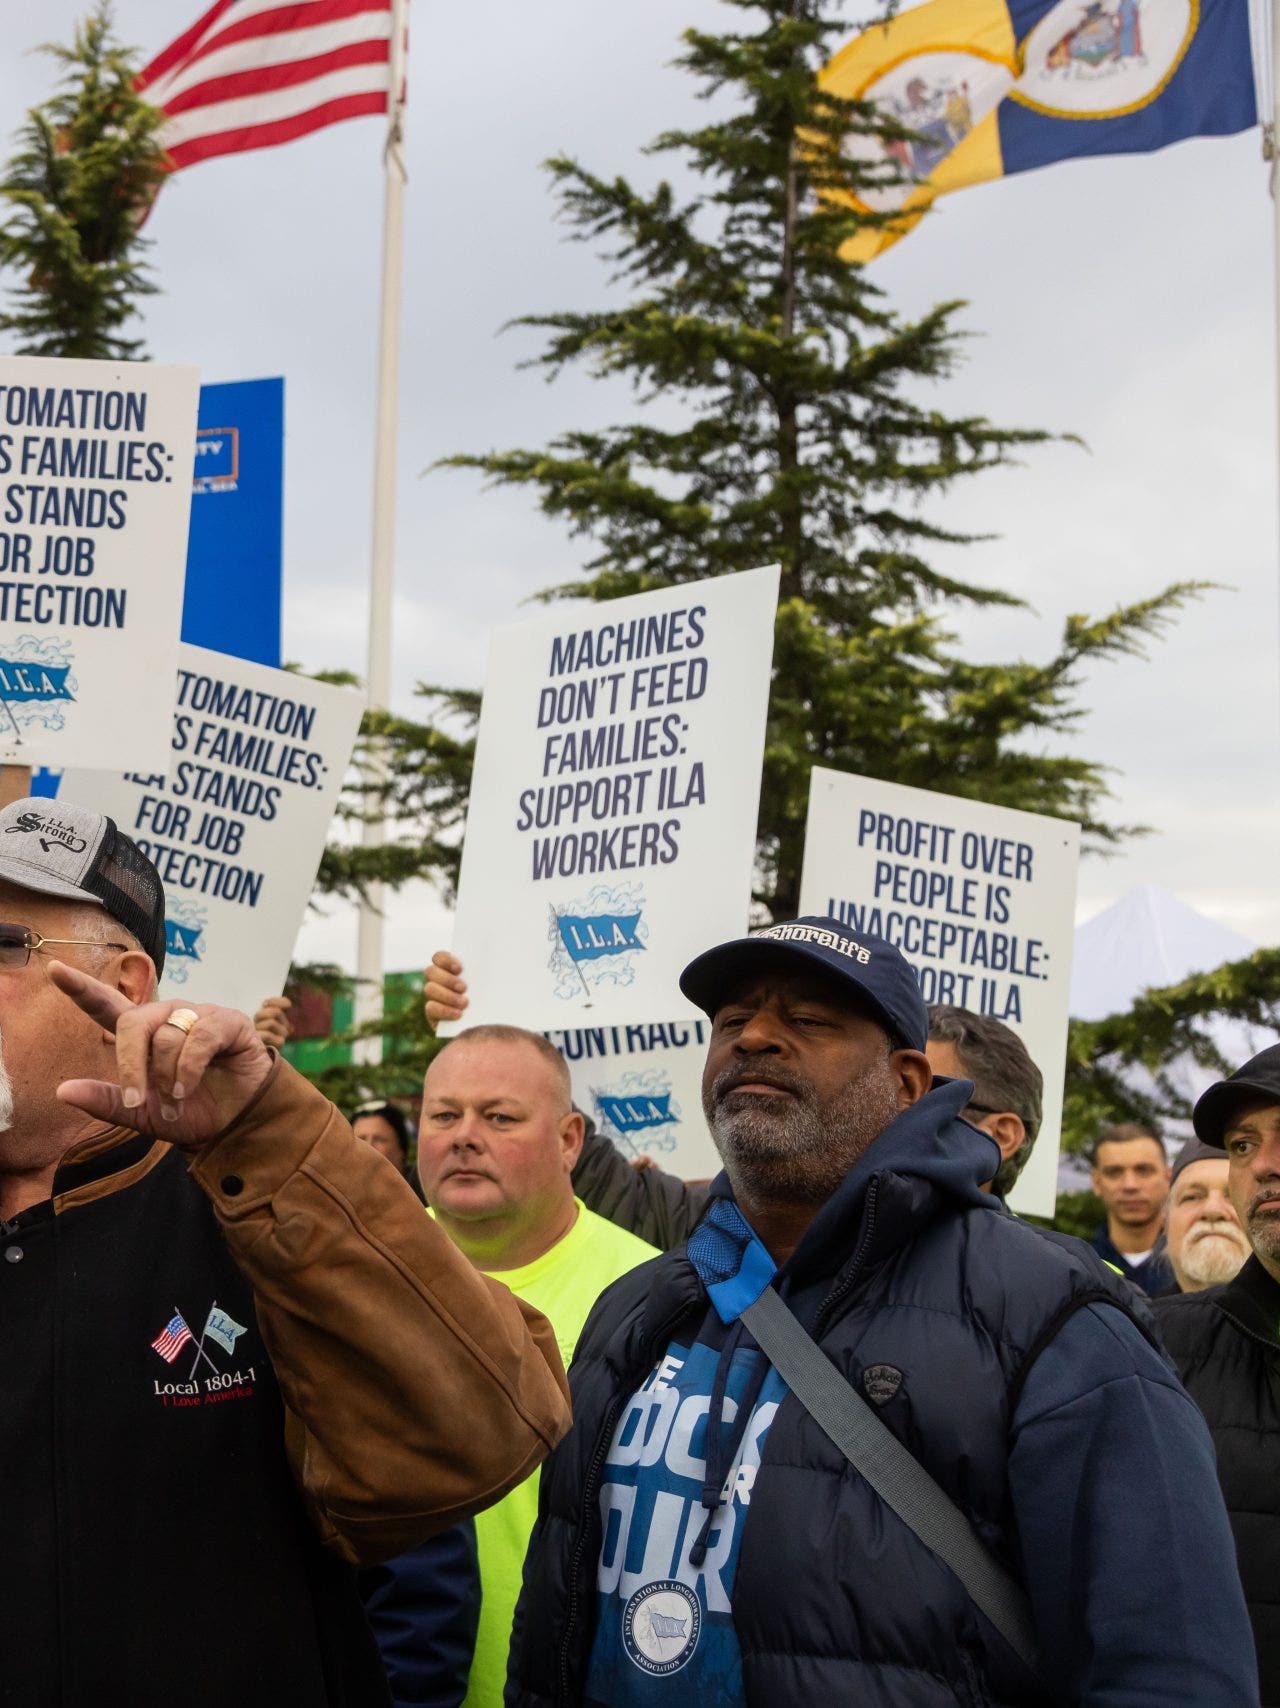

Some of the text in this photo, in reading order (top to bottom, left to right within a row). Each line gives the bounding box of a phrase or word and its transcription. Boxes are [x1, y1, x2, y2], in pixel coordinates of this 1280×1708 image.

[20, 436, 174, 483] FAMILIES:
[4, 484, 128, 530] STANDS
[38, 535, 95, 577] JOB
[549, 605, 707, 677] MACHINES
[177, 668, 318, 742] TOMATION
[537, 657, 708, 729] DON'T FEED
[193, 724, 329, 791] FAMILIES:
[543, 713, 689, 777] FAMILIES:
[172, 761, 282, 822] STANDS
[517, 761, 706, 832] SUPPORT ILA
[5, 812, 76, 845] Strong
[133, 794, 246, 857] FOR JOB
[532, 819, 680, 881] WORKERS
[858, 809, 1034, 882] PROFIT OVER
[874, 860, 1011, 924] PEOPLE IS
[980, 978, 1023, 1024] ILA
[154, 1367, 257, 1395] Local 1804-1
[173, 1395, 200, 1407] Love
[204, 1386, 254, 1405] America
[625, 1583, 670, 1636] INTERNATIONAL
[634, 1653, 680, 1672] ASSOCIATION
